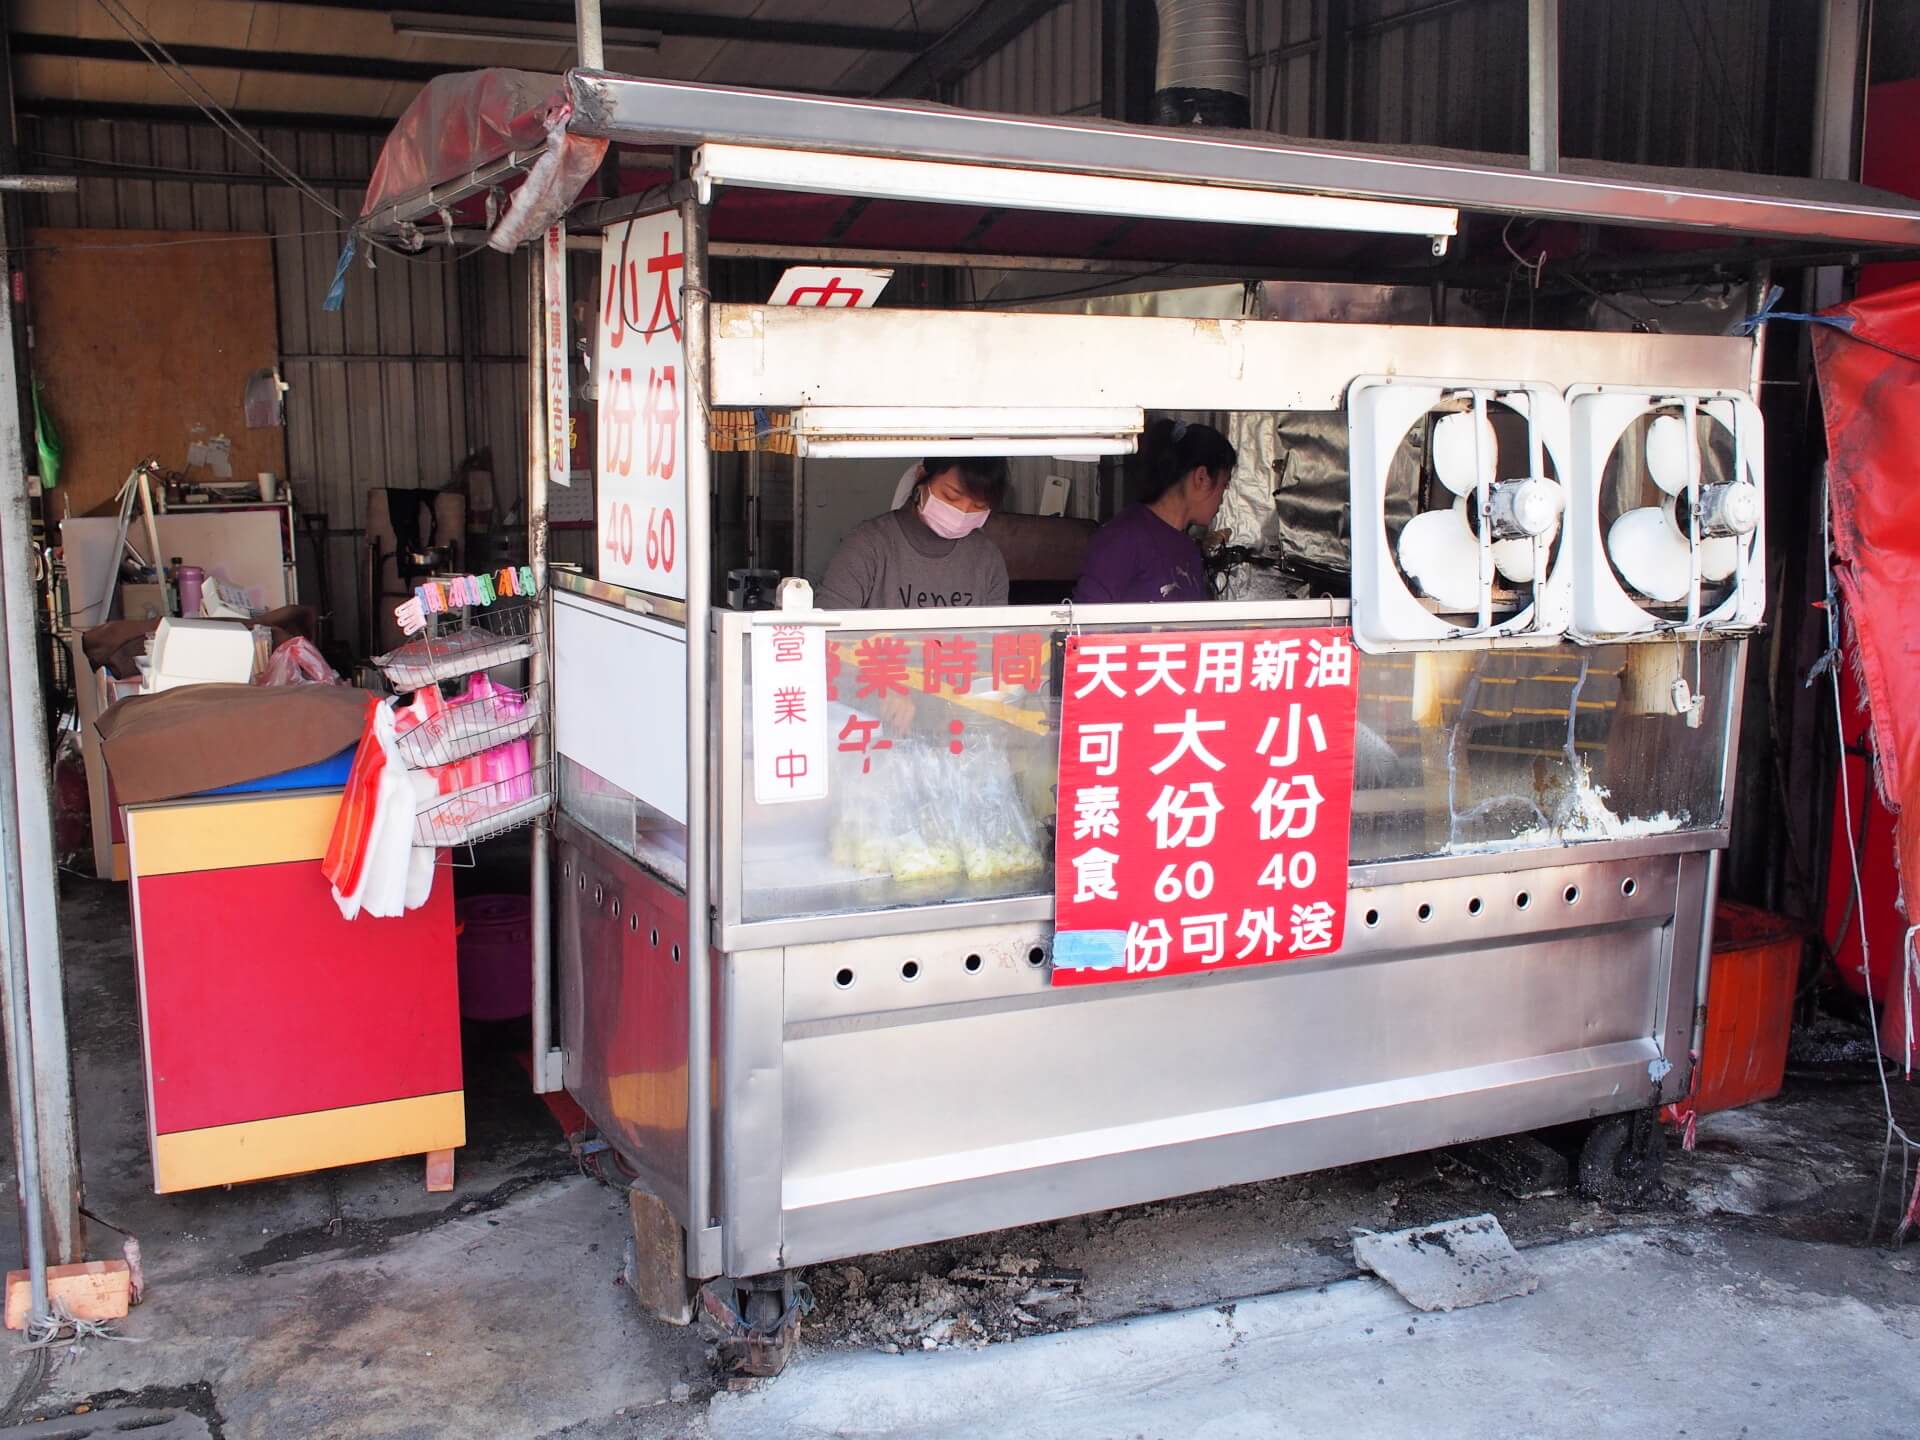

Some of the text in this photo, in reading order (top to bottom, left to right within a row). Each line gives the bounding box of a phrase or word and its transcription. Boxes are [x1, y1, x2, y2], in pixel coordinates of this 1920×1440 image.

[602, 240, 639, 566] 小份 40
[642, 231, 684, 573] 大份 60
[772, 625, 807, 788] 營業中
[826, 633, 1042, 701] 業時間
[1073, 637, 1351, 700] 天天用新油
[1071, 722, 1124, 904] 可素食
[1146, 707, 1226, 903] 大份 60
[1250, 702, 1328, 890] 小份 40
[1074, 901, 1336, 974] 份可外送
